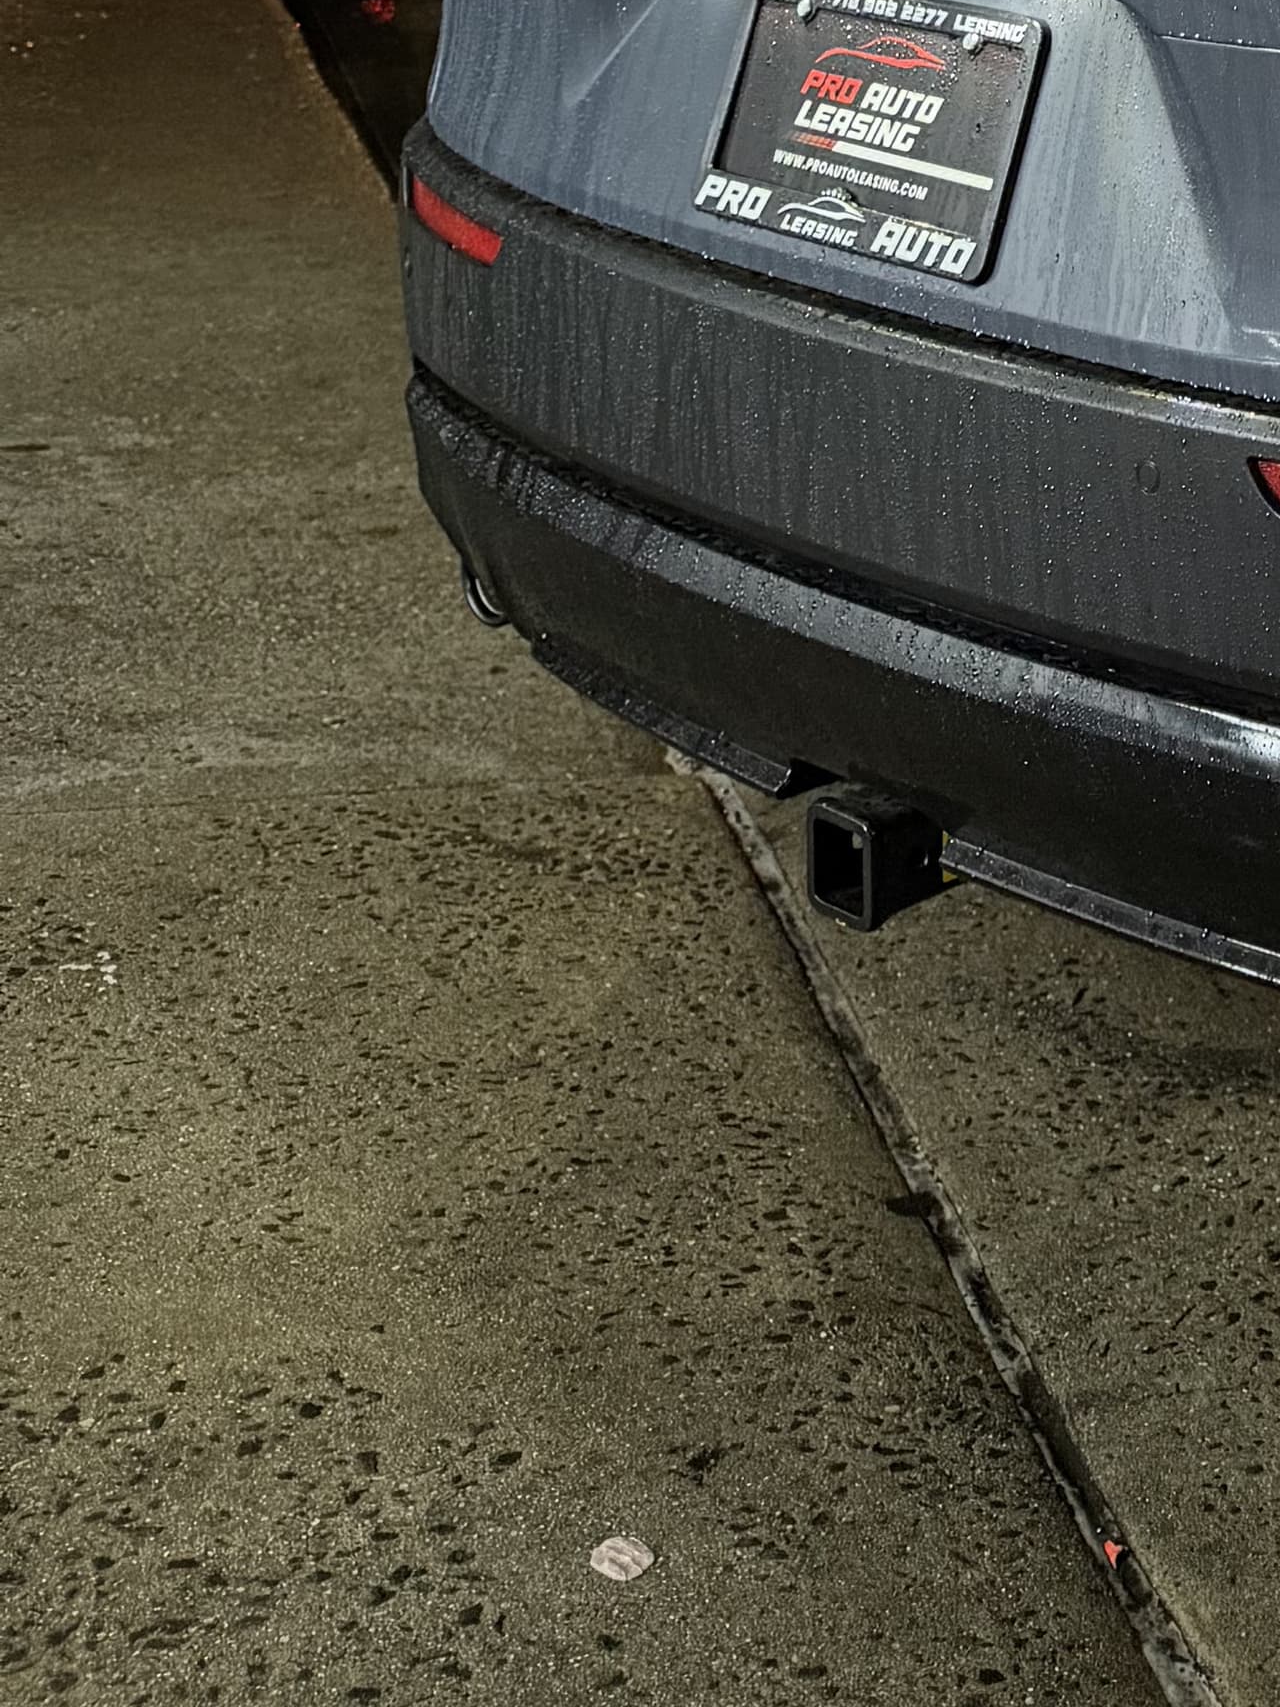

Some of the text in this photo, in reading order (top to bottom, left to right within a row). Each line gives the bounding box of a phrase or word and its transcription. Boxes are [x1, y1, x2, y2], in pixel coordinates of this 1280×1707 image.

[900, 2, 949, 27] 2277
[953, 14, 1026, 43] LEASING
[800, 69, 945, 124] PRO AUTO
[794, 99, 921, 152] LEASING
[773, 149, 929, 201] WWW.PROAUTOLEASING.COM
[694, 174, 977, 275] PRO LEASING AUTO
